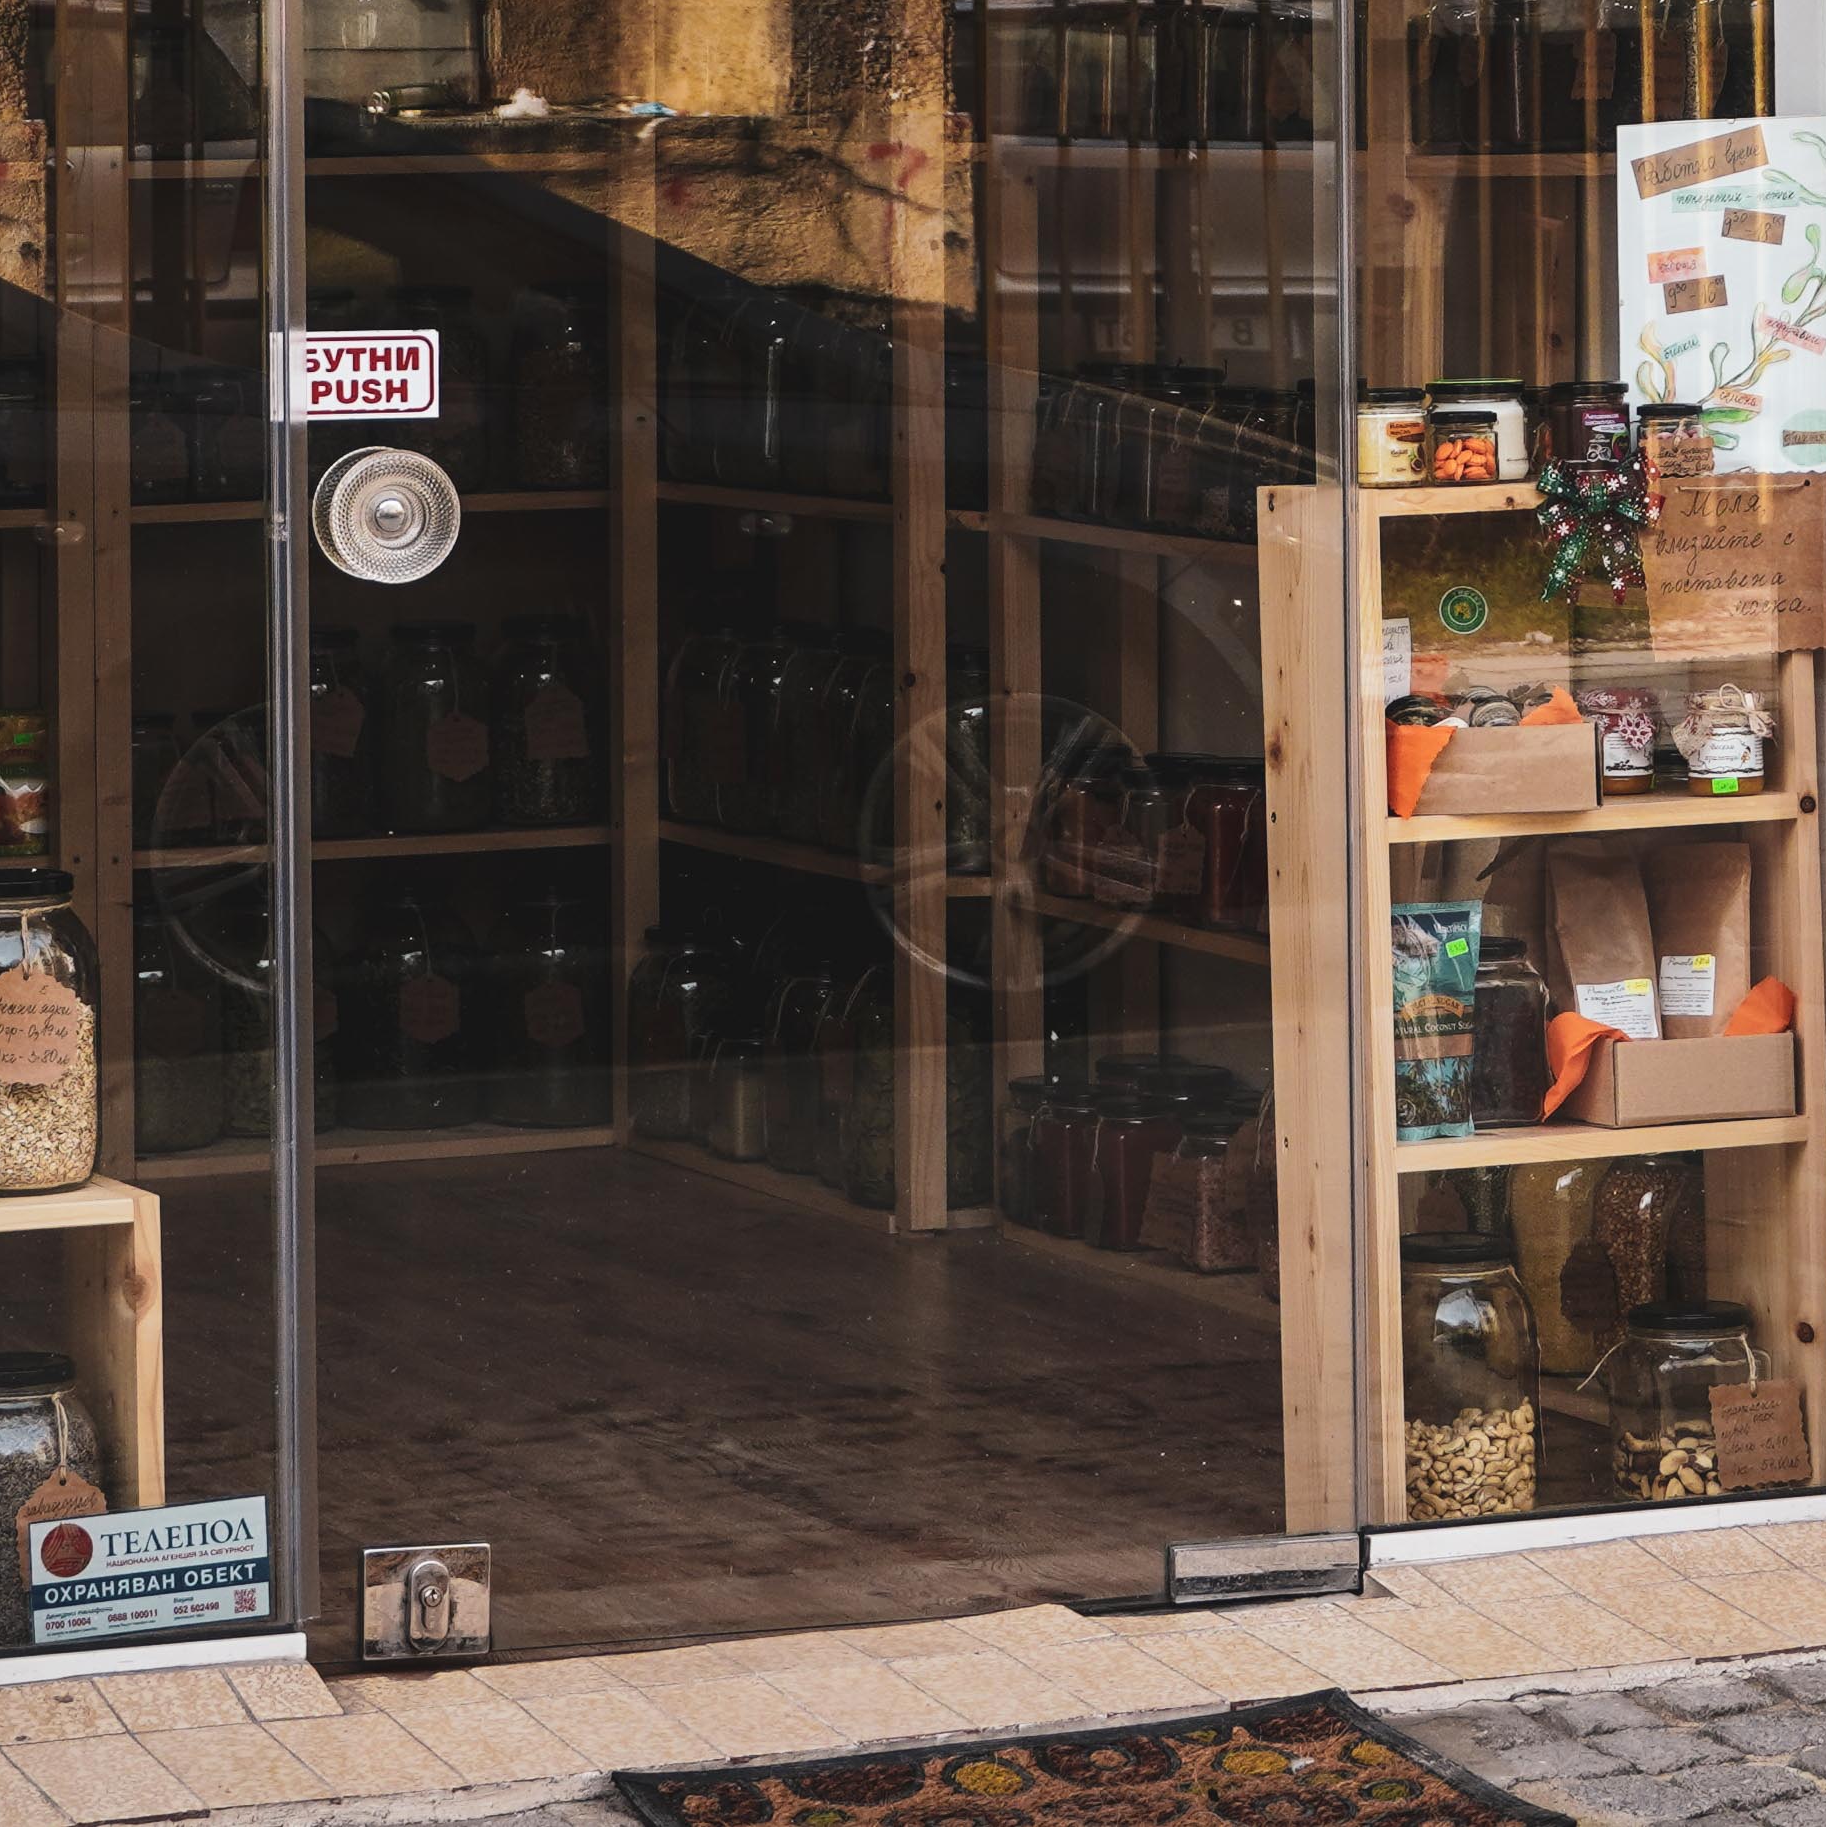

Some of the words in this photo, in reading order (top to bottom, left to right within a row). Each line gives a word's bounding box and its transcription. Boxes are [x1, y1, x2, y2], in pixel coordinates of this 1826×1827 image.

[311, 379, 409, 405] PUSH
[100, 1517, 254, 1557] ТЕЛЕПОЛ
[106, 1555, 160, 1568] НАЦИОНАЛНА
[198, 1550, 209, 1558] ЗА
[44, 1572, 176, 1605] ОХРАНЯВАН
[184, 1563, 258, 1588] ОБЕКТ
[45, 1620, 65, 1631] 0700
